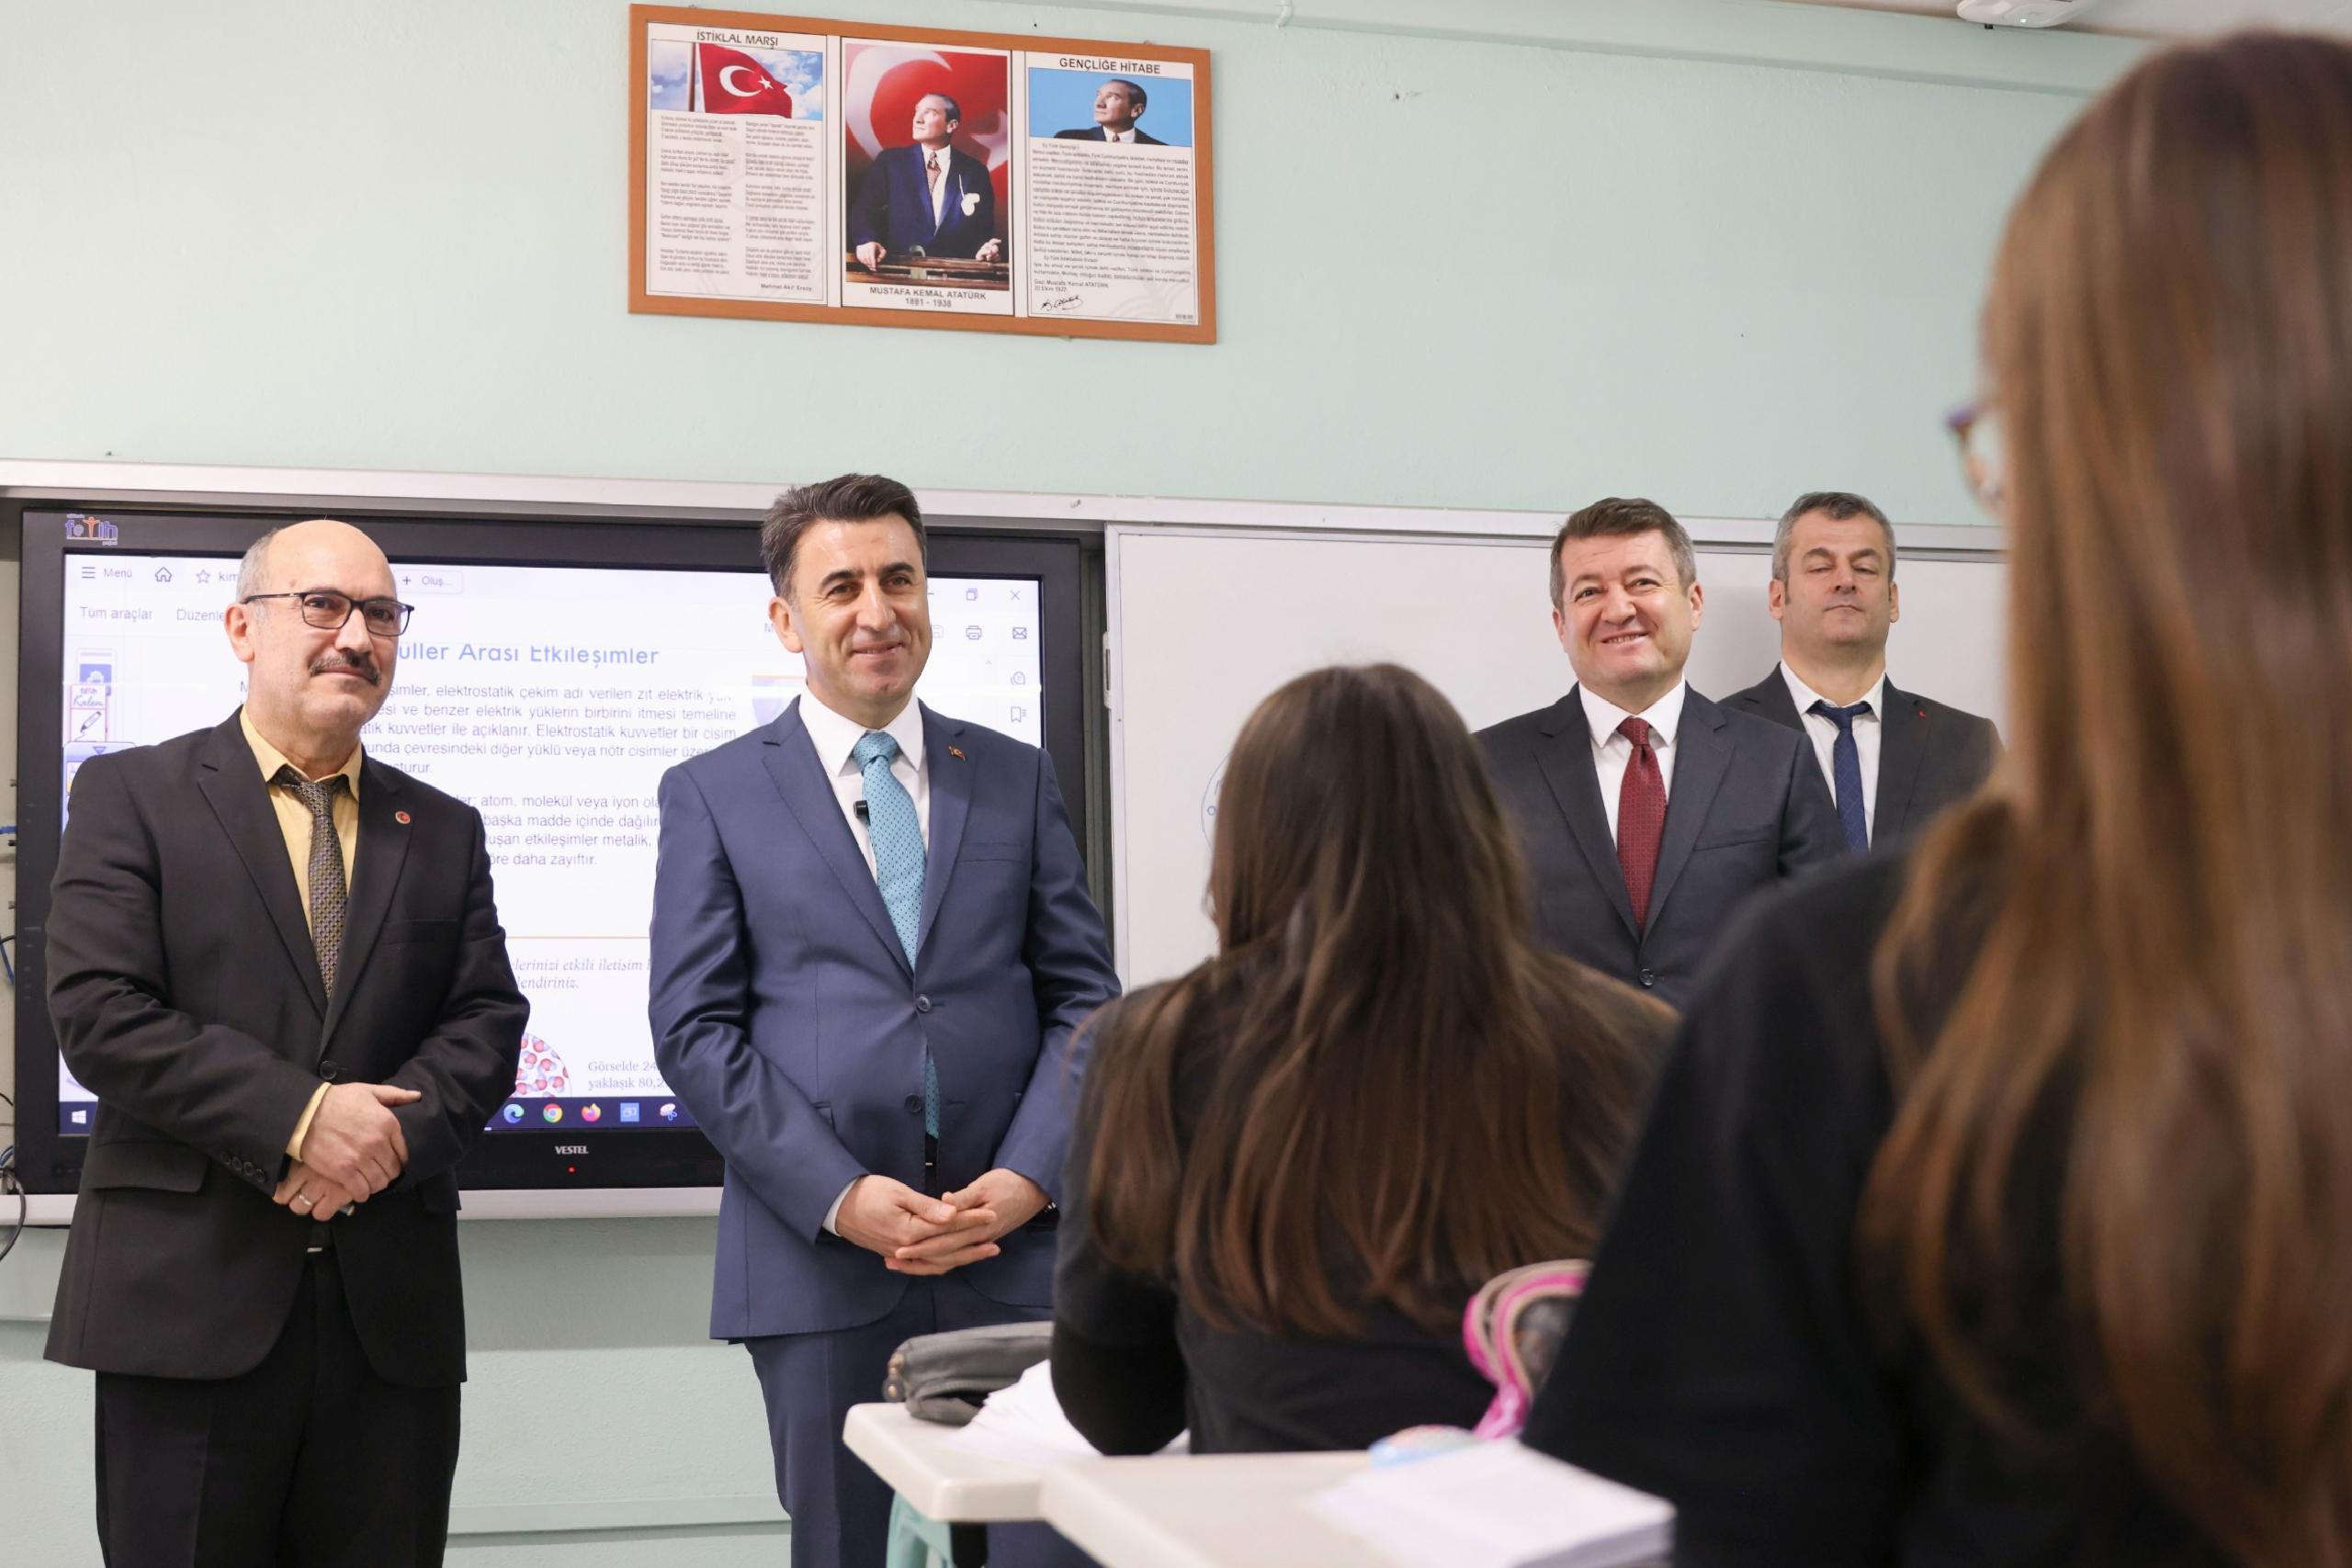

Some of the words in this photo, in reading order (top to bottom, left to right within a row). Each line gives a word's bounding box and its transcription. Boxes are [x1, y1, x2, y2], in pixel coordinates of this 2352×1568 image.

[696, 29, 742, 43] İSTİKLAL
[745, 35, 779, 49] MARŞI
[1059, 57, 1117, 71] GENÇLİĞE
[1120, 60, 1161, 74] HİTABE
[869, 286, 910, 296] MUSTAFA
[913, 288, 944, 299] KEMAL
[947, 290, 986, 300] ATATÜRK
[933, 299, 952, 308] 1938
[104, 568, 132, 579] Menü
[219, 571, 239, 581] kim
[110, 609, 153, 623] araçlar
[458, 643, 519, 662] Arası
[390, 684, 430, 699] şimler,
[435, 685, 514, 698] elektrostatik
[519, 686, 558, 700] çekim
[563, 688, 582, 699] adı
[589, 688, 632, 700] verilen
[638, 690, 653, 700] zıt
[658, 689, 704, 701] elektrik
[402, 707, 419, 716] ve
[424, 705, 469, 716] benzer
[476, 705, 522, 717] elektrik
[529, 706, 579, 719] yüklerin
[584, 707, 632, 719] birbirini
[638, 708, 676, 720] itmesi
[683, 709, 736, 721] temeline
[361, 724, 382, 735] atik
[388, 724, 447, 736] kuvvetler
[452, 724, 467, 736] ile
[472, 725, 530, 738] açıklanır.
[536, 724, 616, 738] Elektrostatik
[620, 727, 677, 739] kuvvetler
[683, 728, 698, 739] bir
[703, 728, 736, 739] cisim
[367, 742, 401, 753] unda
[404, 742, 487, 756] çevresindeki
[491, 742, 523, 757] diğer
[527, 744, 561, 758] yüklü
[565, 747, 596, 759] veya
[600, 745, 624, 756] nötr
[628, 746, 677, 758] cisimler
[481, 795, 517, 808] atom,
[522, 795, 572, 807] molekül
[577, 797, 608, 809] veya
[613, 797, 639, 809] iyon
[642, 796, 660, 808] ola
[483, 815, 522, 829] başka
[527, 815, 571, 827] madde
[576, 815, 615, 829] içinde
[525, 834, 598, 848] etkileşimler
[603, 834, 651, 847] metalik,
[491, 853, 509, 865] öre
[513, 853, 547, 865] daha
[550, 853, 597, 867] zayıftır.
[514, 958, 559, 970] lerinizi
[562, 958, 594, 970] etkili
[598, 958, 643, 971] iletişim
[588, 1060, 639, 1072] Görselde
[588, 1077, 636, 1091] yaklaşık
[555, 1145, 590, 1155] VESTEL
